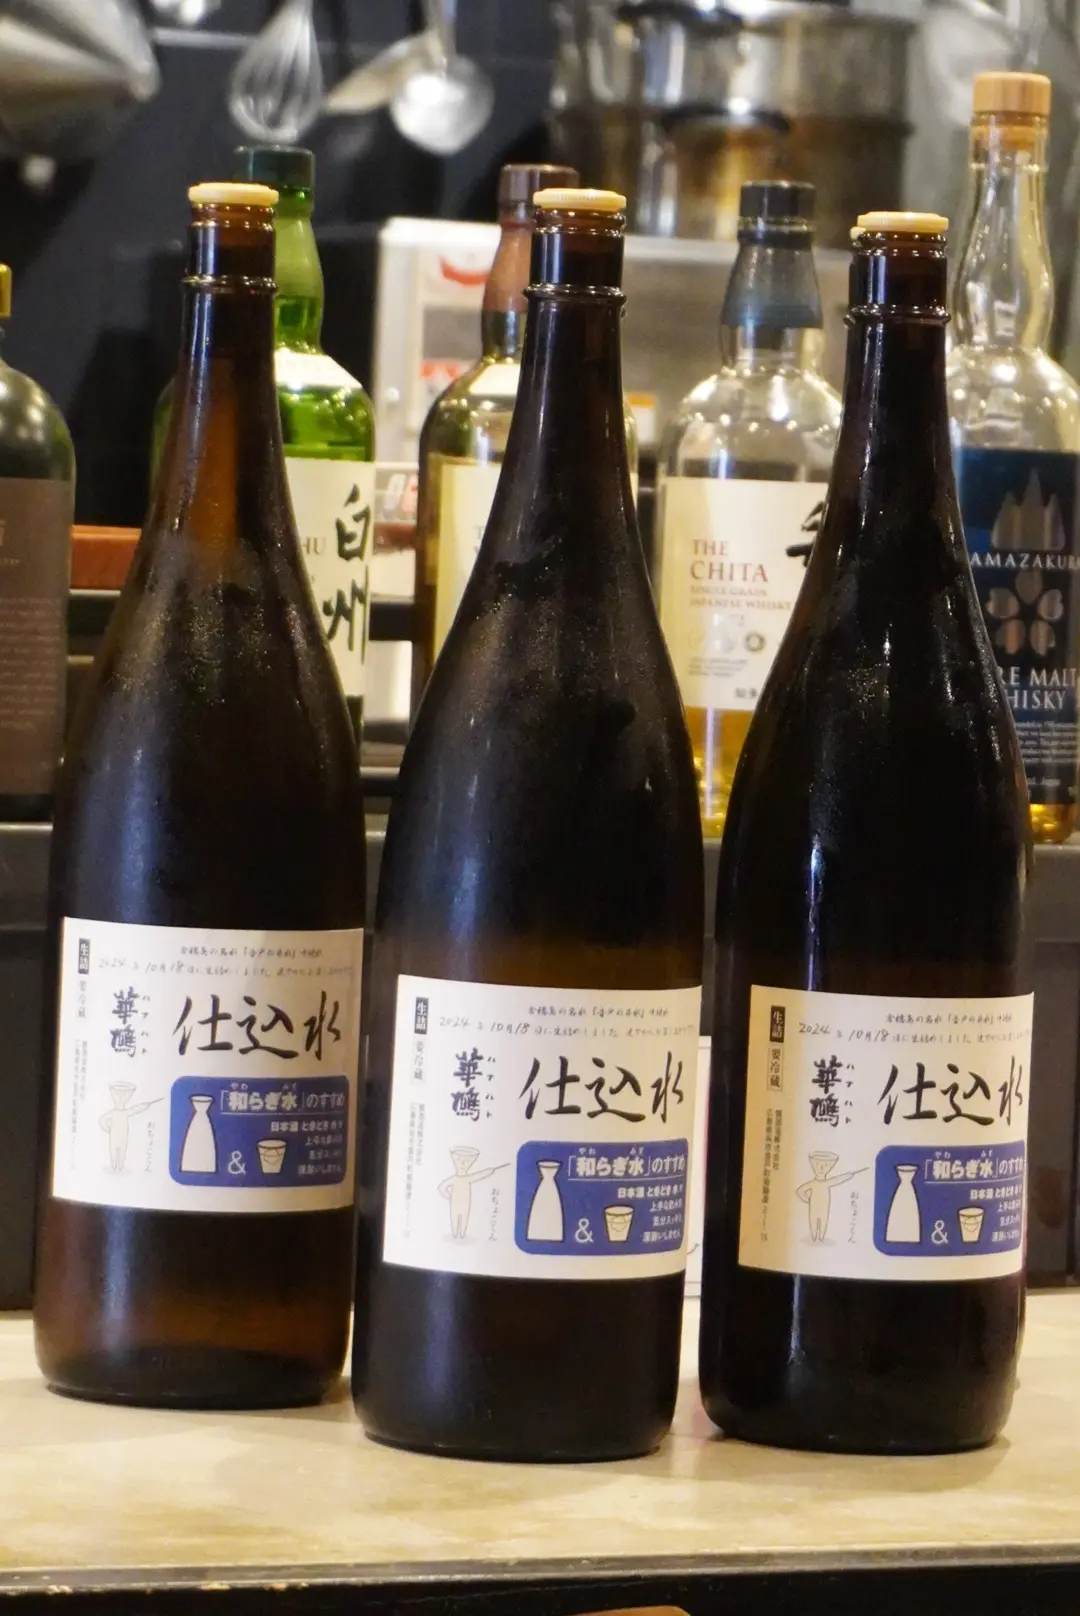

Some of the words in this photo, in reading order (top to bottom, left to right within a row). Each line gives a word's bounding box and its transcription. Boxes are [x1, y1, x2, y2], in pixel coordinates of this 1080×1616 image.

[692, 539, 728, 556] THE
[969, 551, 1080, 569] AMAZAKUR
[322, 484, 371, 665] 白州
[690, 560, 769, 582] CHITA
[1030, 668, 1077, 686] MALT
[1004, 690, 1066, 709] HISKY
[173, 990, 341, 1061] 仕込水
[771, 1010, 783, 1040] 生詰
[518, 1051, 684, 1124] 仕込水
[877, 1055, 1023, 1126] 仕込水
[227, 1150, 246, 1175] &
[574, 1218, 594, 1244] &
[931, 1219, 948, 1244] &
